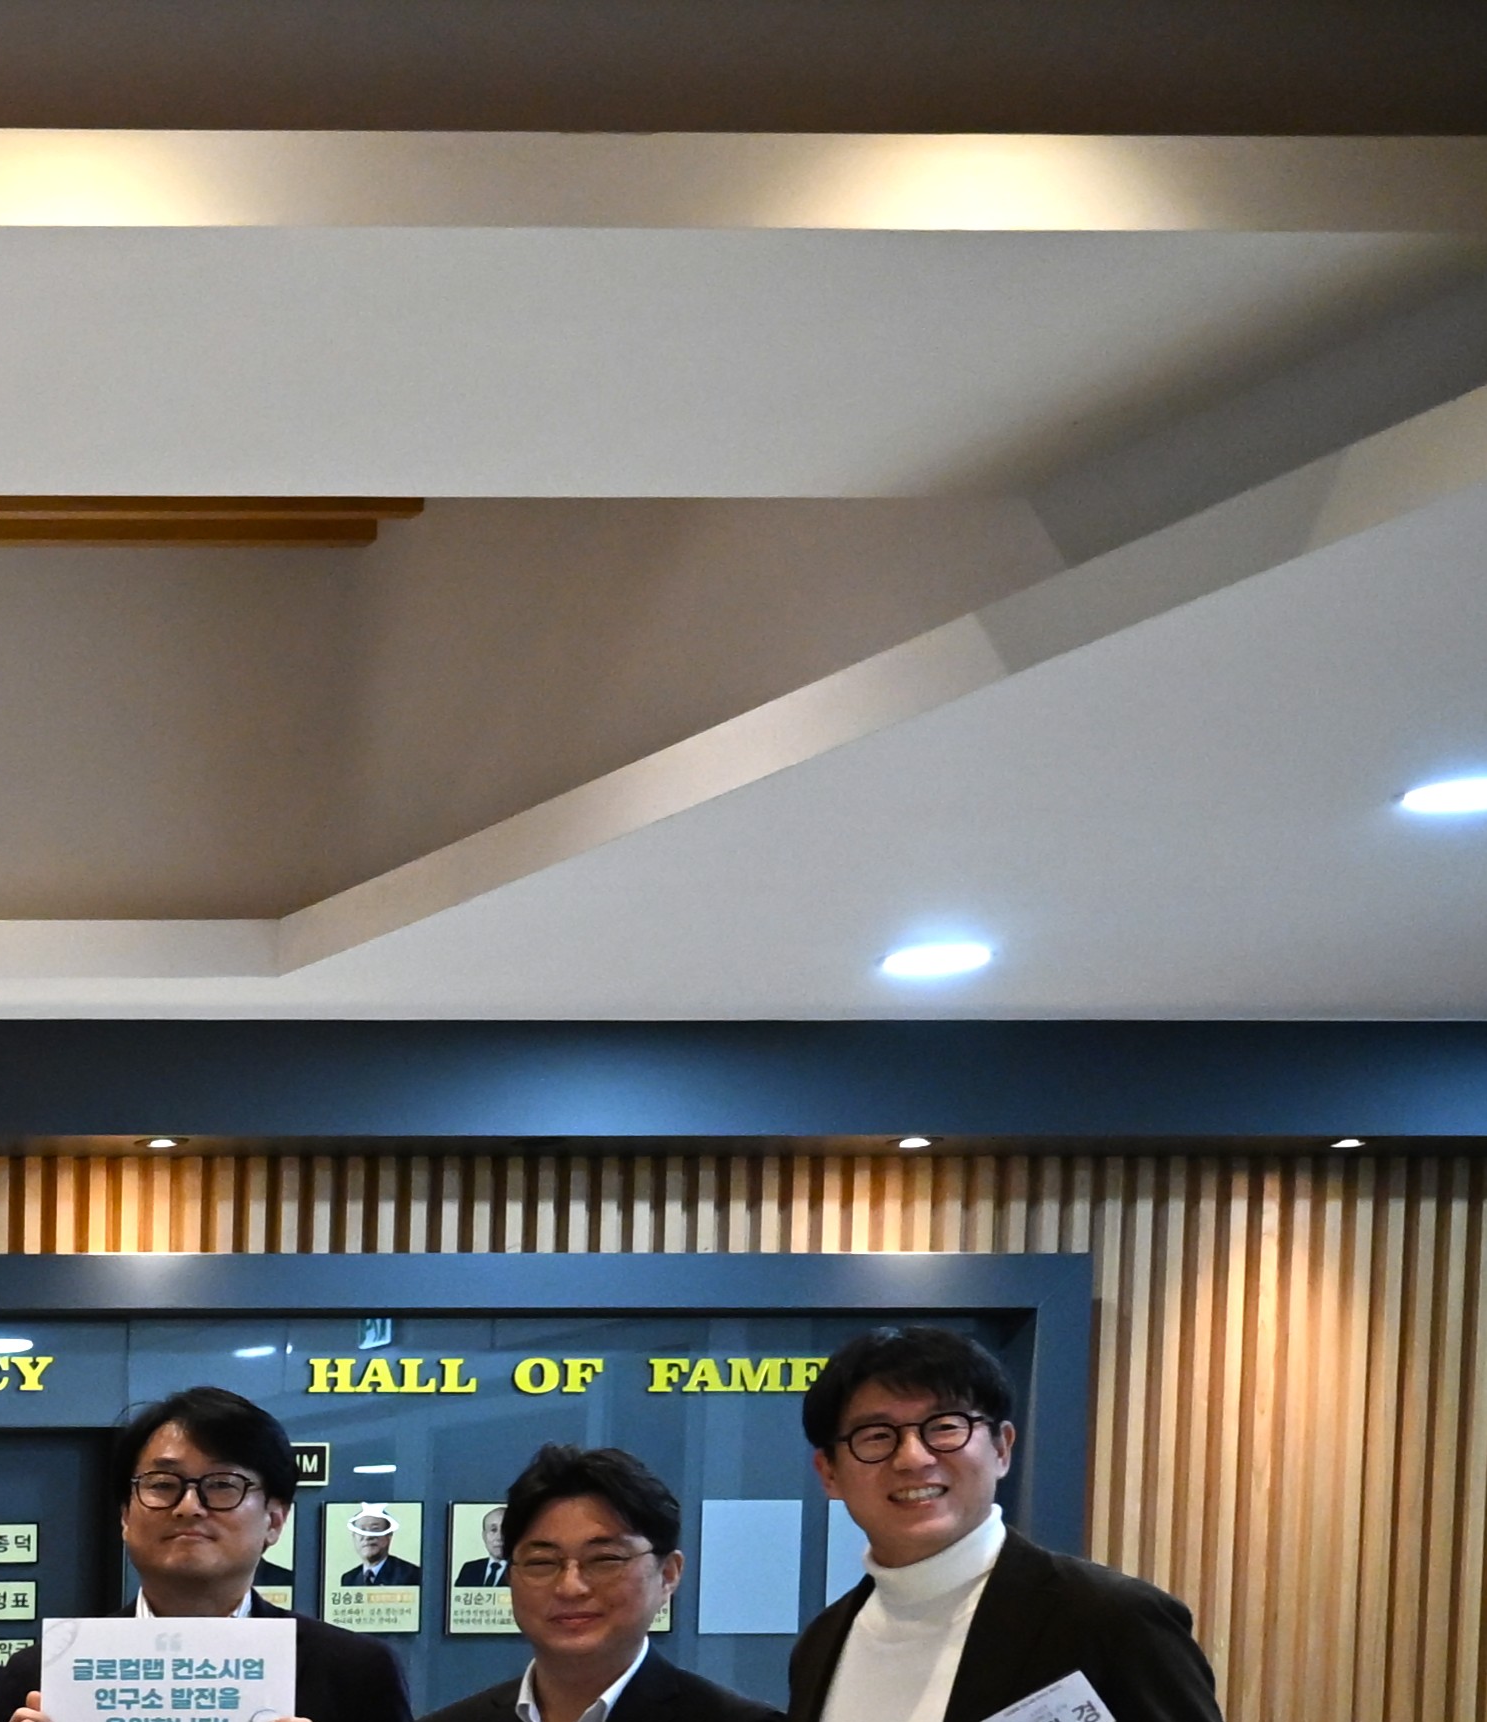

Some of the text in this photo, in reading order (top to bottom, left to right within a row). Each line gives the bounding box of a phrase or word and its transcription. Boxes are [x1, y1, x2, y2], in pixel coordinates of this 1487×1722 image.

[308, 1359, 477, 1393] HALL
[514, 1358, 603, 1393] OF
[72, 1658, 265, 1682] 글로컬랩 컨소시엄
[94, 1686, 242, 1711] 연구소 발전을
